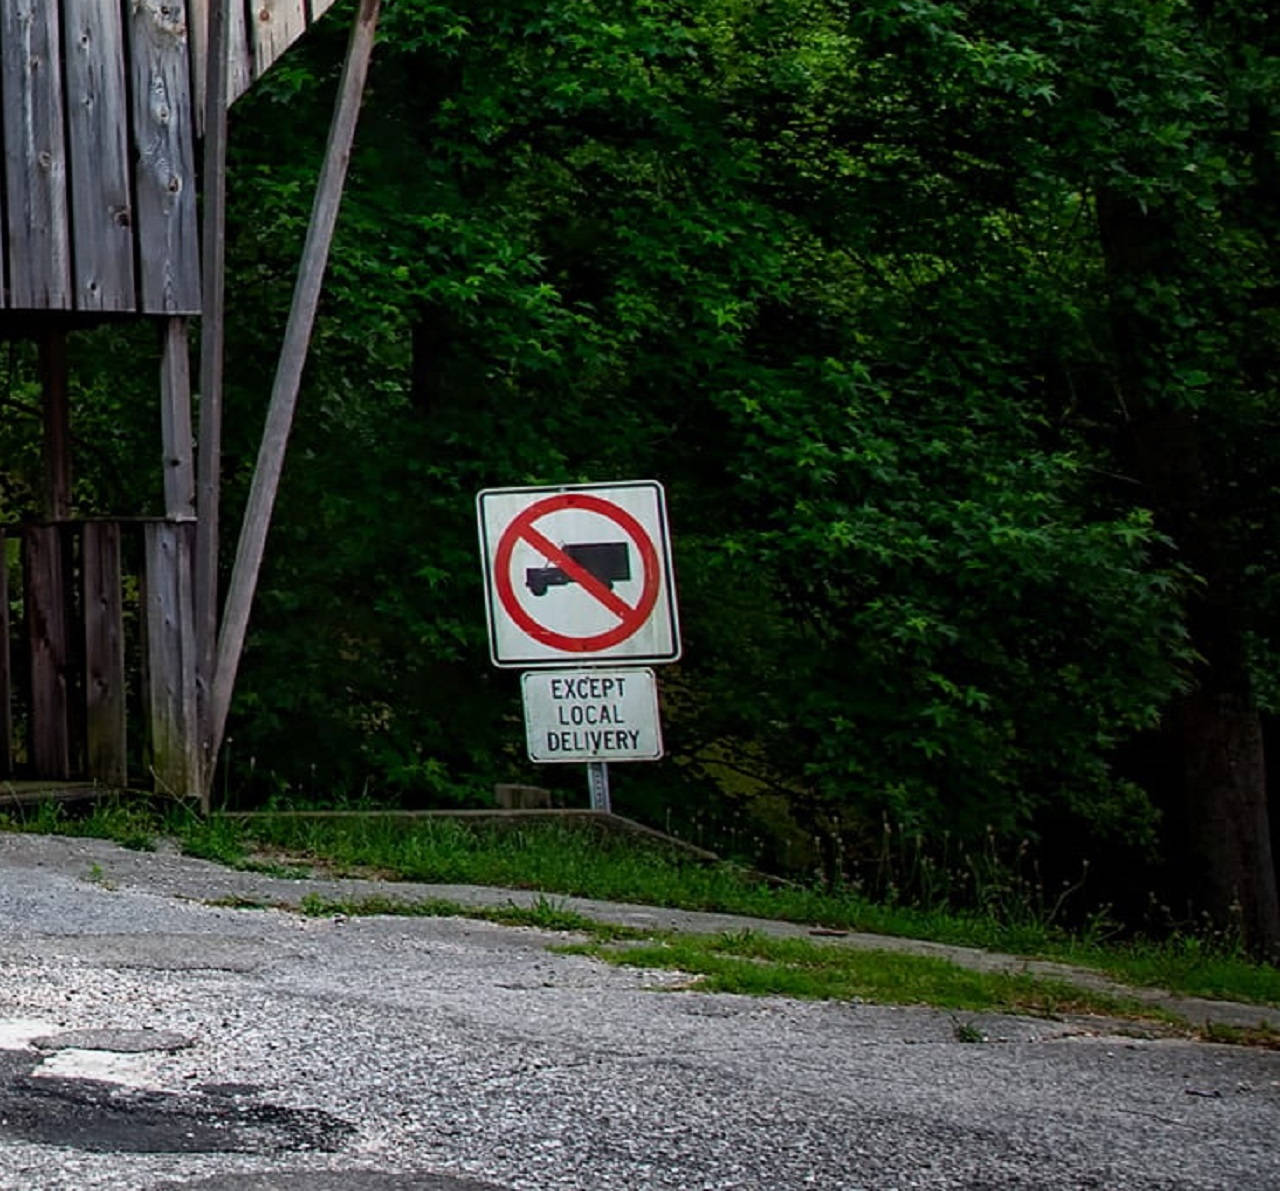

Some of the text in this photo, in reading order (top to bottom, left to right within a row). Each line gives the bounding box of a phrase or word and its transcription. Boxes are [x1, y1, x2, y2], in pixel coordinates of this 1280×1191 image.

[552, 677, 626, 699] EXCEPT
[559, 705, 624, 725] LOCAL
[547, 729, 640, 751] DELIVERY
